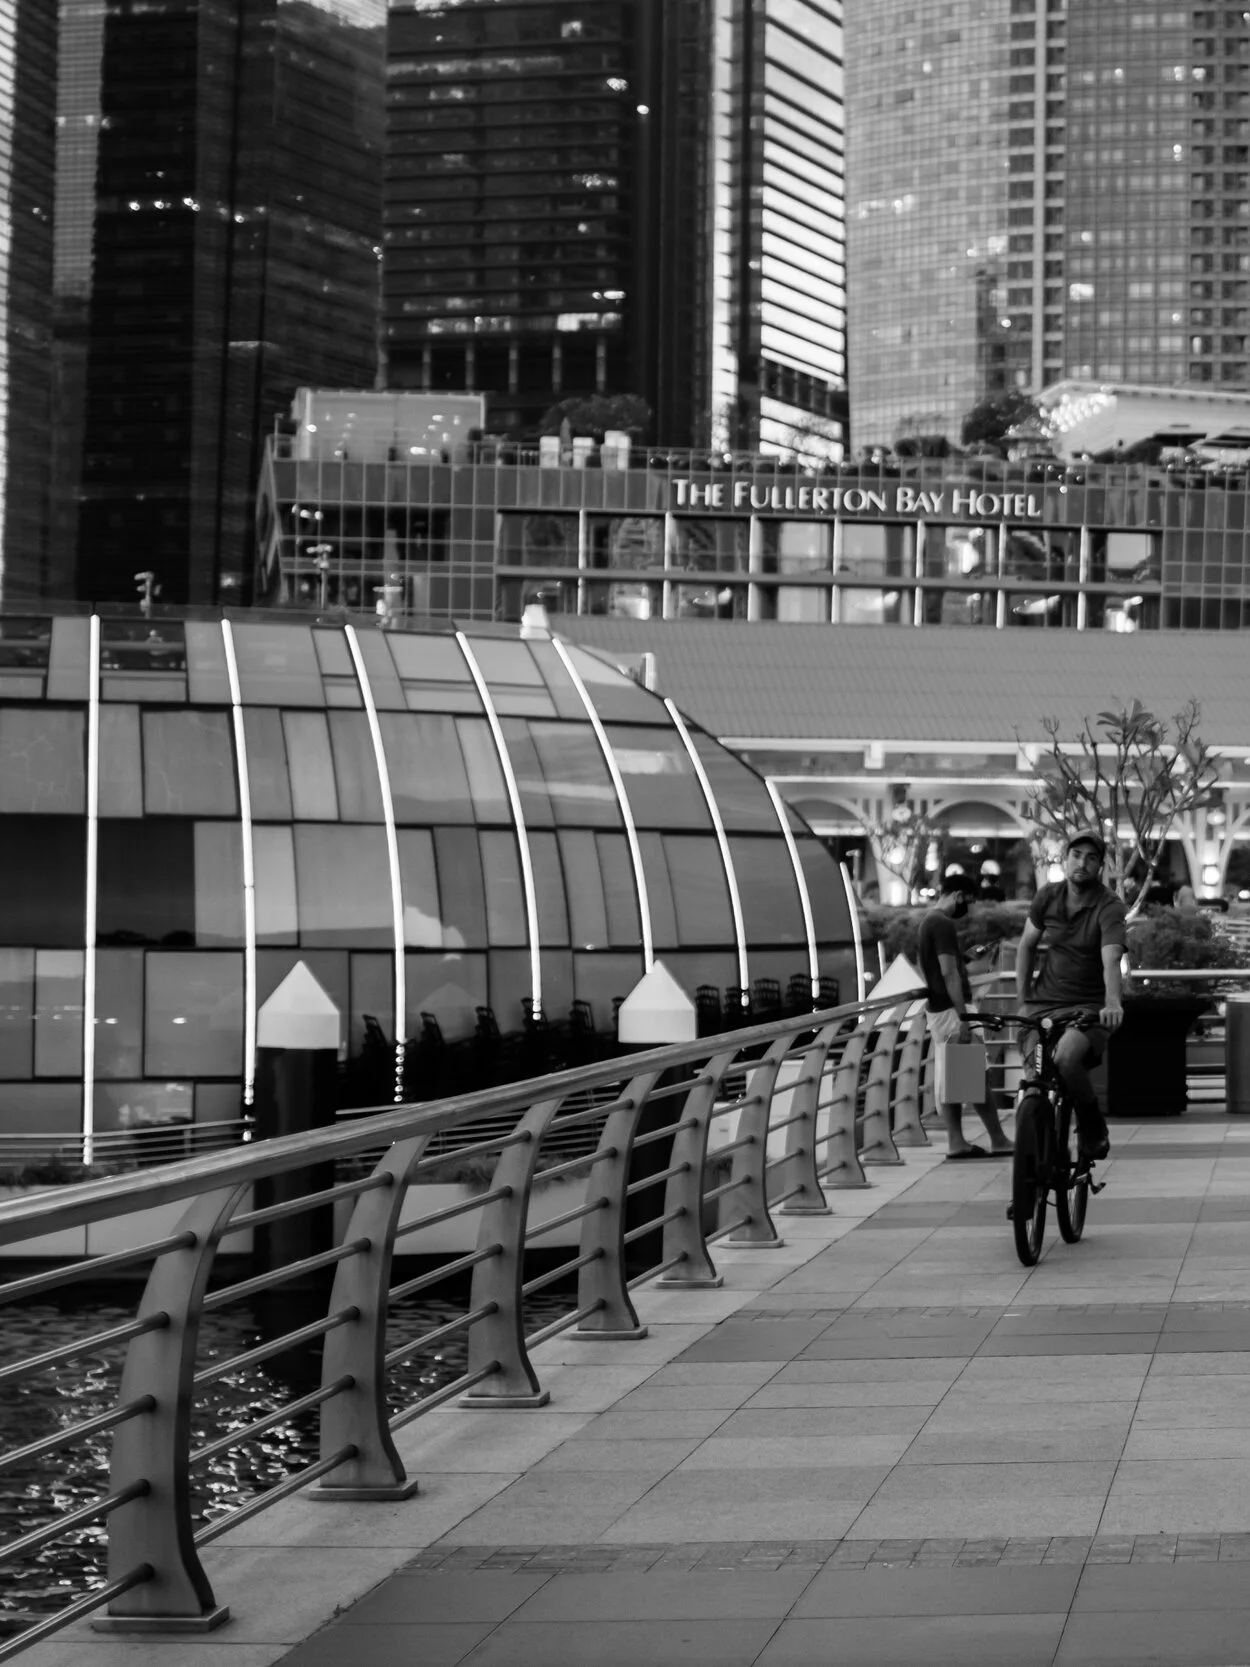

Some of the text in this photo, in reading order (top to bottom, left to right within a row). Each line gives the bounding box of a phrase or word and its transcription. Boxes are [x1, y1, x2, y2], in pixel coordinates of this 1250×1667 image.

[672, 478, 1041, 517] THE FULLERTON BAY HOTEL
